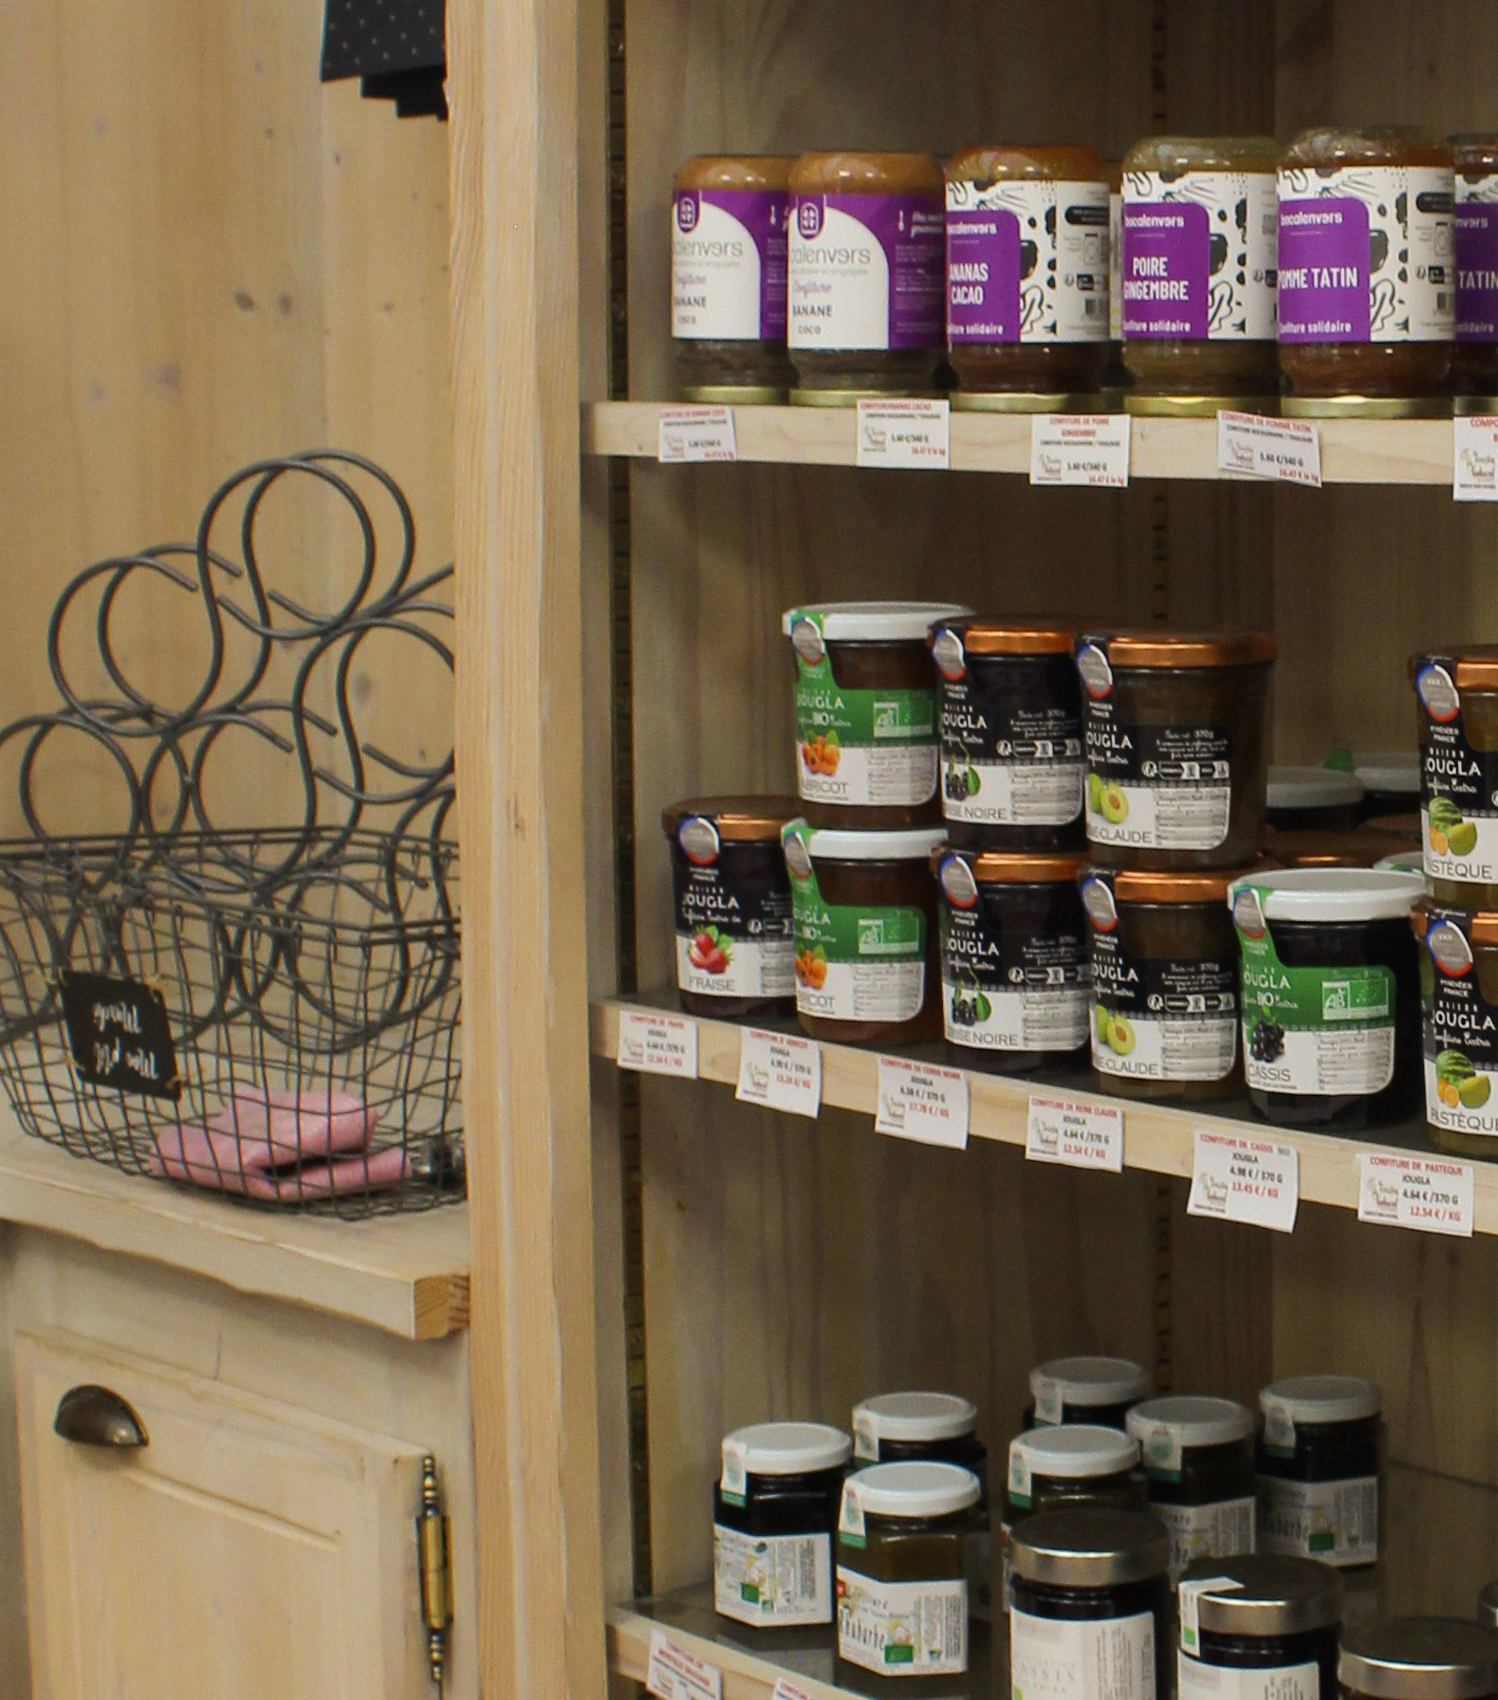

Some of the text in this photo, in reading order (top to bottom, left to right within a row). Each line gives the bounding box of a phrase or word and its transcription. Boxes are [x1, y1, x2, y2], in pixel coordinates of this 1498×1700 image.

[1133, 256, 1168, 277] POIRE
[1279, 267, 1358, 290] POMME TATIN
[951, 285, 984, 305] CACAO
[1124, 280, 1189, 301] GINGEMBRE
[1149, 320, 1191, 334] solidaire
[1309, 320, 1352, 336] solidaire
[798, 692, 845, 710] OUGLA
[943, 715, 988, 730] OUGLA
[1087, 731, 1133, 749] OUGLA
[964, 807, 1007, 820] NOIRE
[1426, 857, 1493, 880] STÈQUE
[686, 895, 740, 910] OUGLA
[946, 939, 999, 957] OUGLA
[1092, 963, 1139, 982] OUGLA
[1243, 971, 1291, 989] OUGLA
[687, 978, 736, 992] FRAISE
[973, 1032, 1018, 1047] NOIRE
[1370, 1156, 1463, 1176] CONFITURE DE PASTEQUE
[1402, 1174, 1431, 1186] JOUGLA
